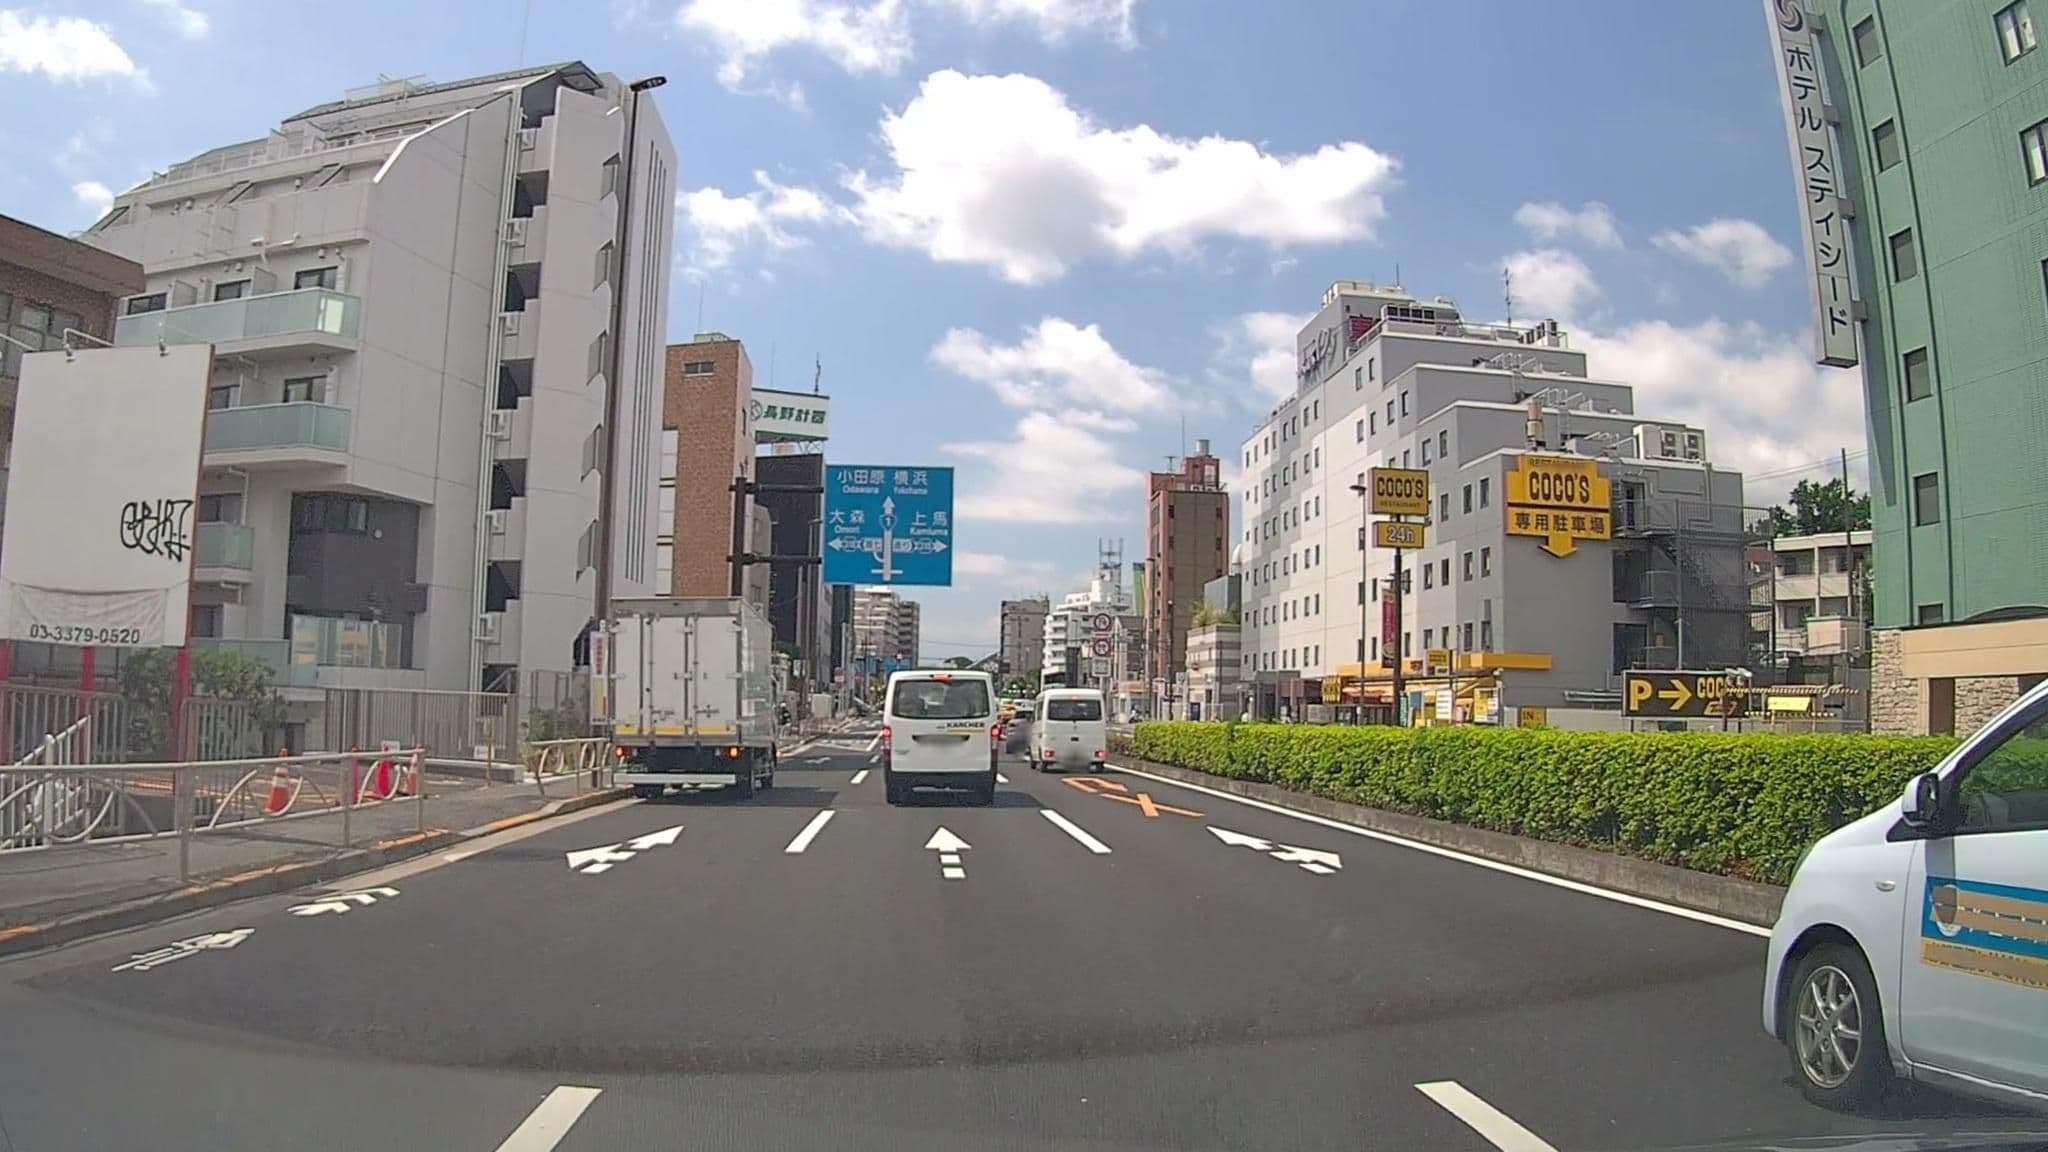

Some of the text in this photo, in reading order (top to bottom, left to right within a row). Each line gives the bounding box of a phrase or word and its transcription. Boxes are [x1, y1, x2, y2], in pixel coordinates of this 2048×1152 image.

[1786, 47, 1848, 336] ホテル ステイシード
[837, 469, 928, 486] 小田原 横浜
[1377, 476, 1424, 499] COCO'S
[1529, 471, 1590, 503] COCO'S
[829, 508, 865, 524] 大森
[911, 510, 948, 527] 上馬
[1515, 512, 1604, 534] 専用駐車場
[834, 525, 860, 534] Omori
[1387, 526, 1416, 543] 24h
[30, 623, 141, 645] 03-3379-0520
[1629, 679, 1653, 711] P
